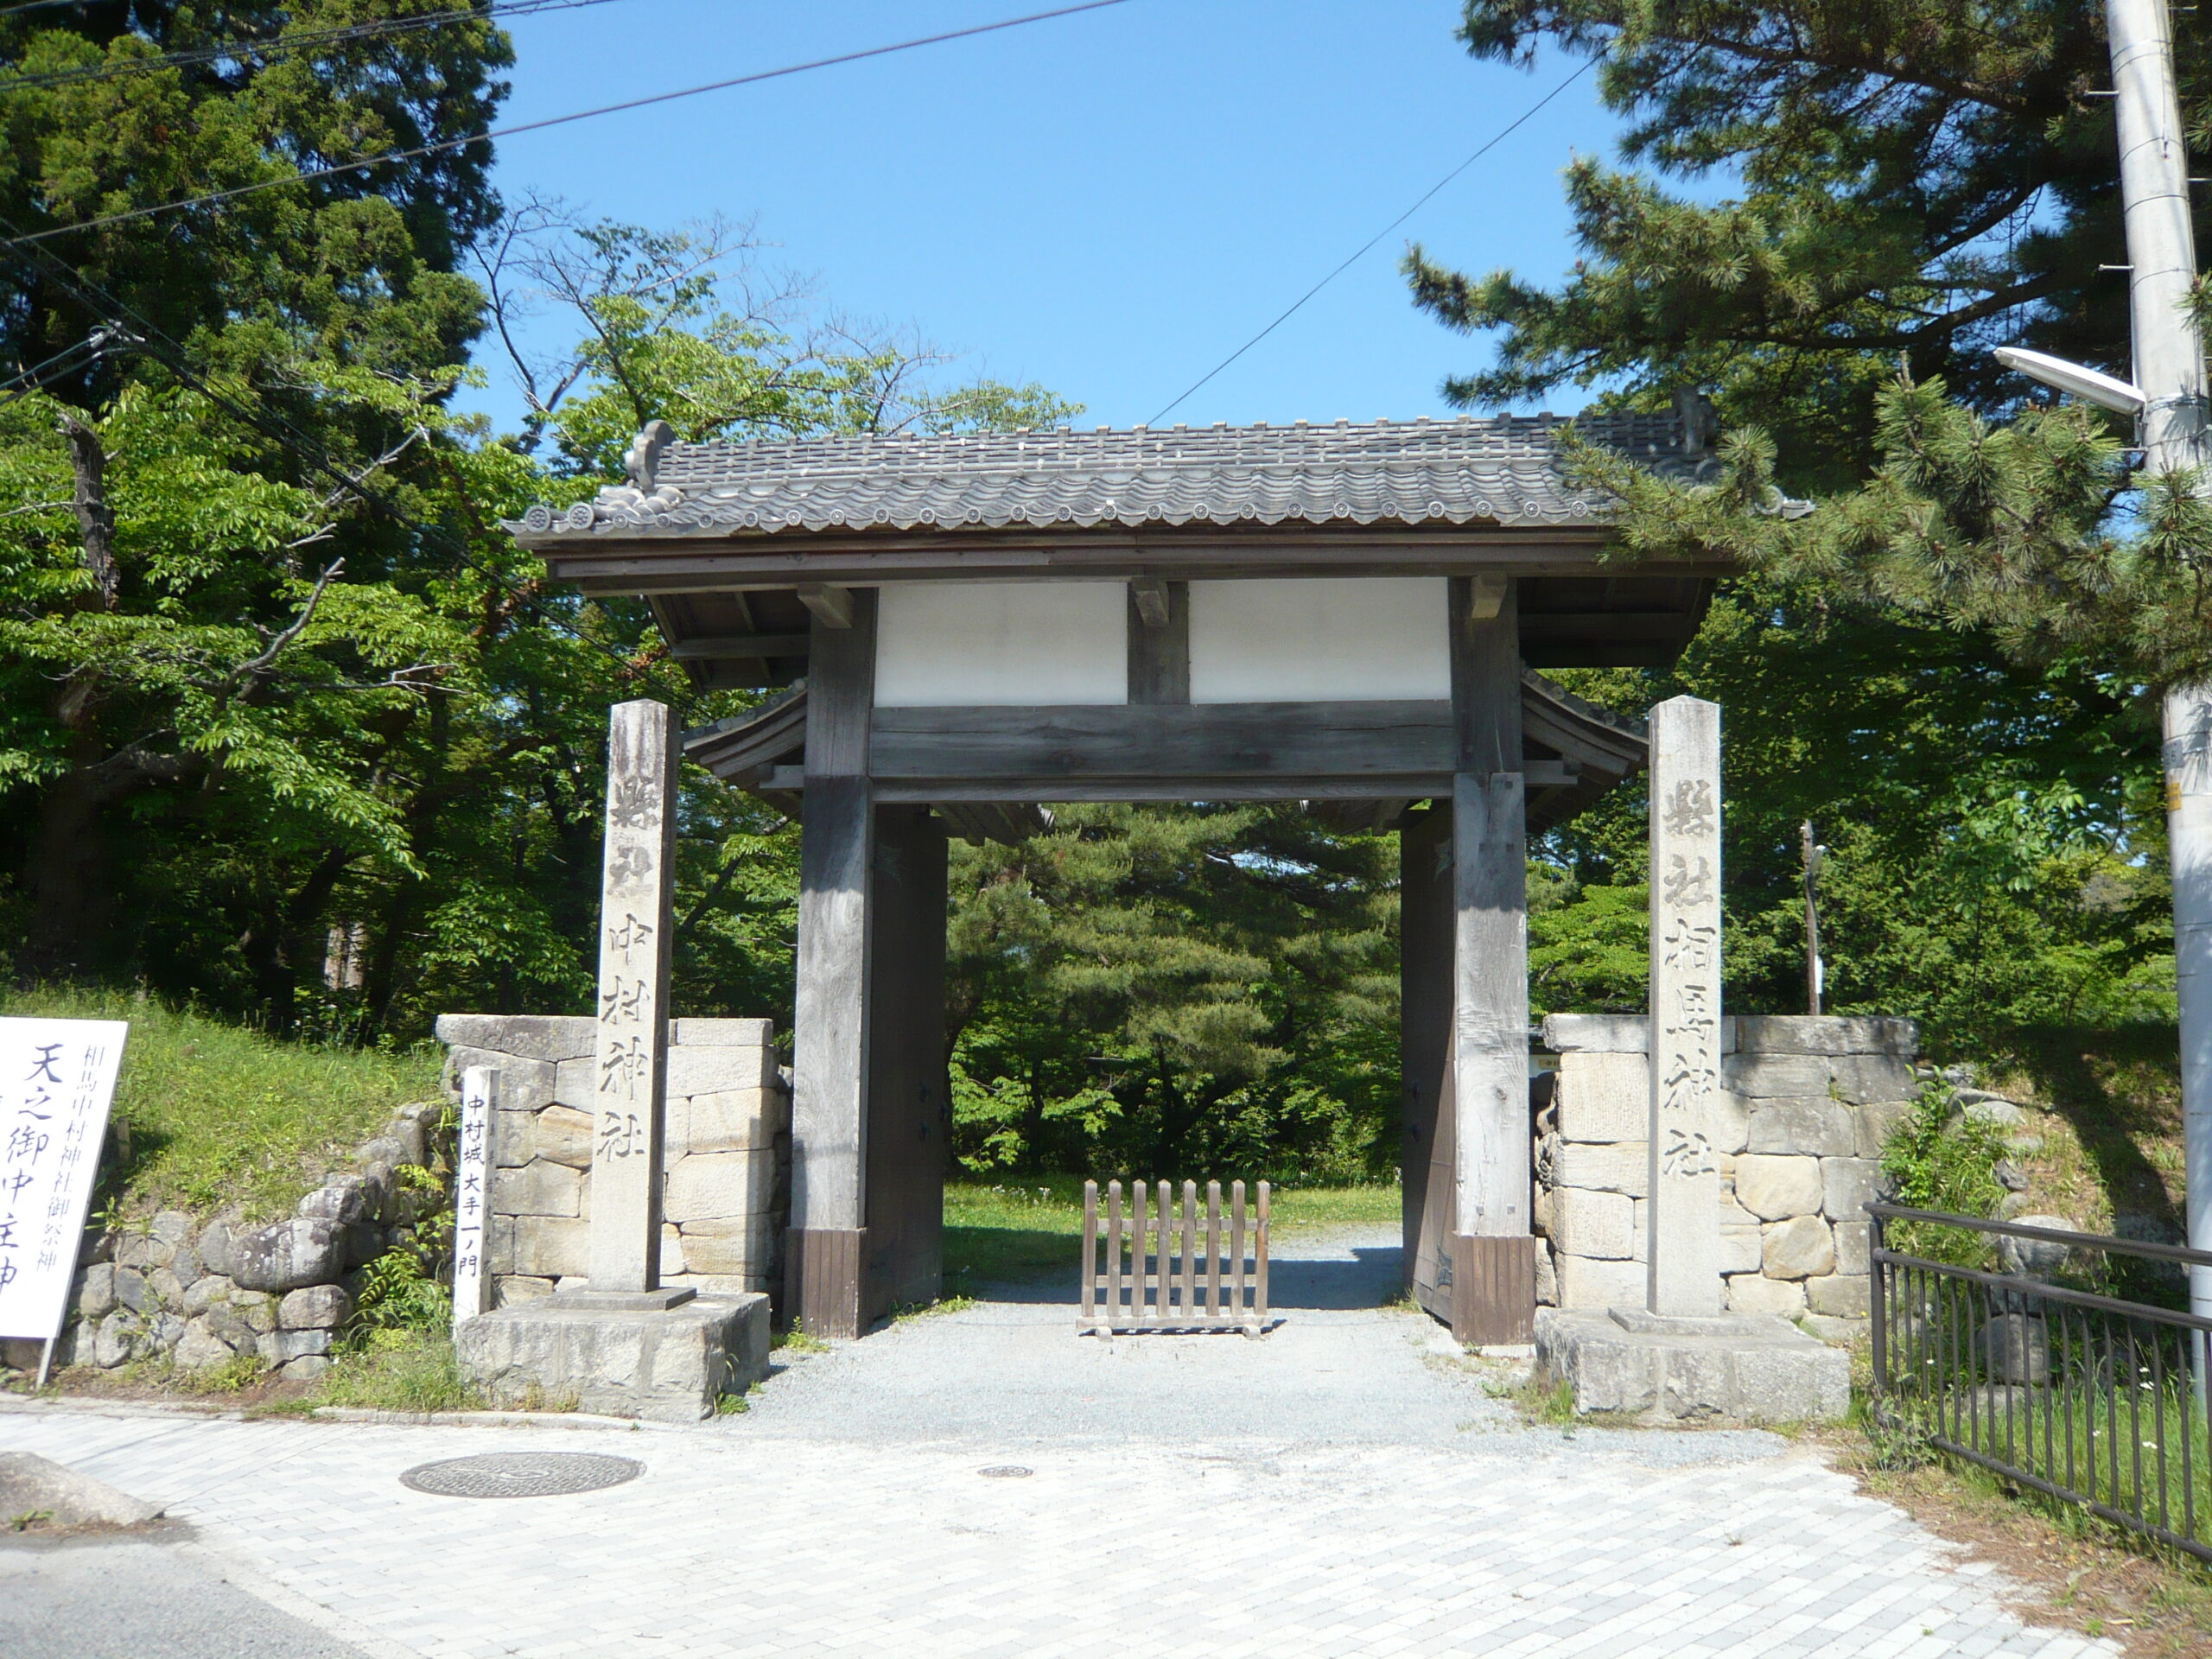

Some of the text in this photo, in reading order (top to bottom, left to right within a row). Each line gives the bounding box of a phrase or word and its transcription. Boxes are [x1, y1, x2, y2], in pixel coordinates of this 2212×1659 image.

[459, 1095, 485, 1277] 中村城大手一ノ門
